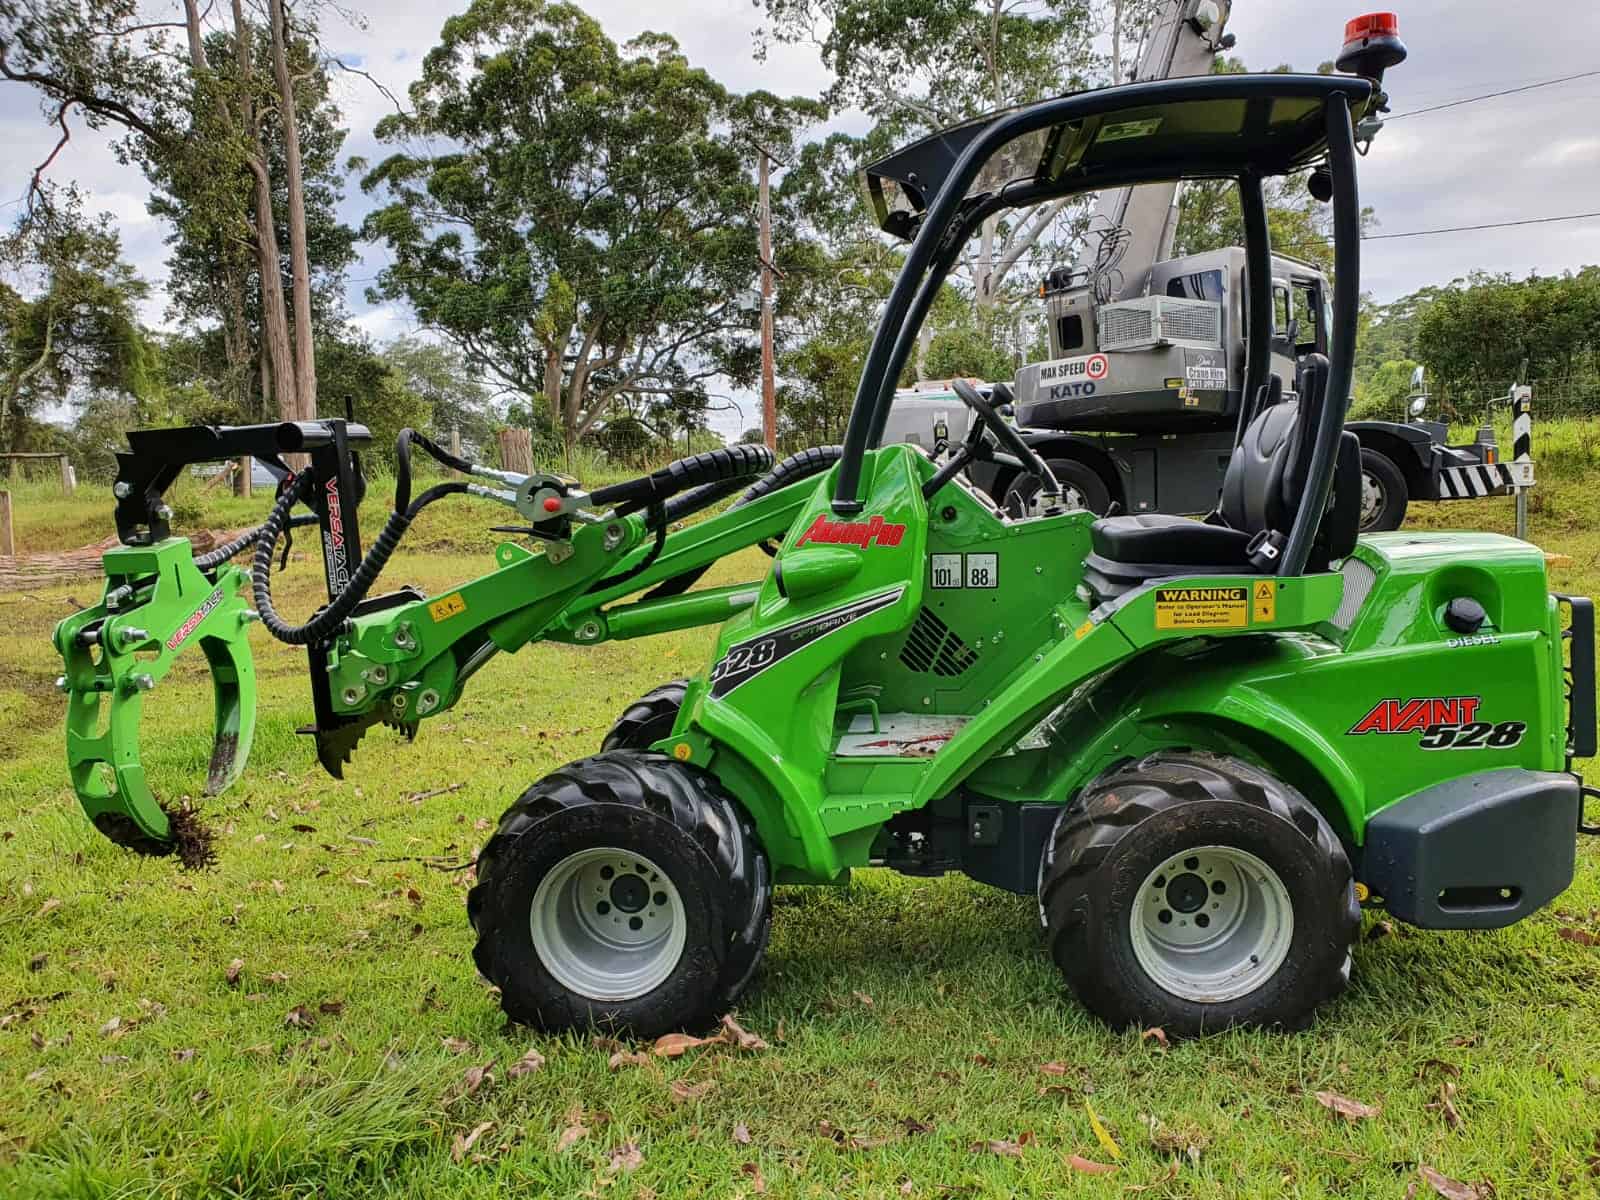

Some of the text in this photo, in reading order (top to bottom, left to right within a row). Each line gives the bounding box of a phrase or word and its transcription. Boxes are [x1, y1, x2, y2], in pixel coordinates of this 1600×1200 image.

[1040, 361, 1102, 380] MAX SPEED 45
[1049, 381, 1096, 399] KATO
[934, 568, 951, 586] 101
[971, 568, 988, 586] 88
[1163, 589, 1241, 601] WARNING
[1448, 634, 1500, 648] DIESEL
[1345, 696, 1481, 735] AVANT
[1419, 721, 1527, 751] 528
